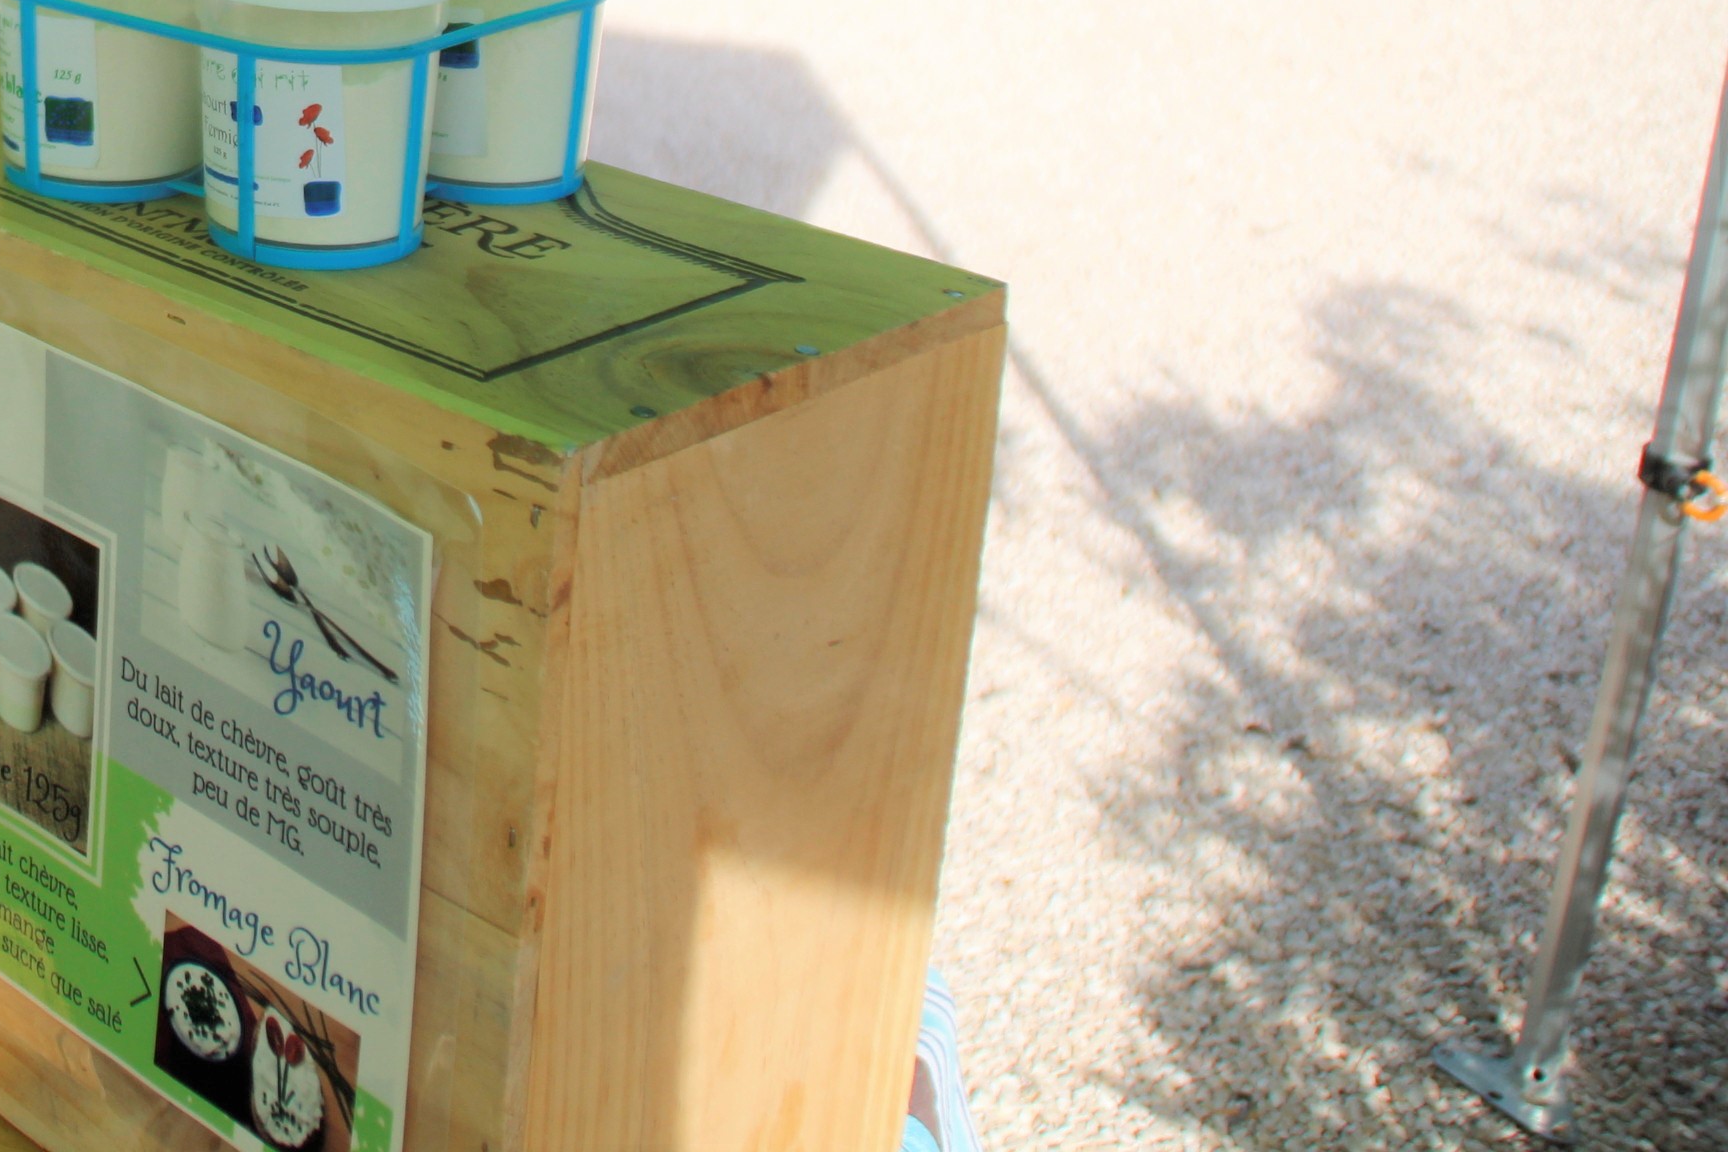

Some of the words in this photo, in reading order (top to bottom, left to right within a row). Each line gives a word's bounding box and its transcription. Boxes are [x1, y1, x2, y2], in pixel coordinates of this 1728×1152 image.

[54, 69, 72, 80] 125
[262, 620, 387, 738] Yaourt
[120, 656, 148, 692] Du
[154, 675, 185, 714] lait
[190, 700, 215, 731] de
[297, 765, 347, 811] goût
[355, 794, 393, 837] très
[187, 732, 259, 791] texture
[265, 777, 301, 818] très
[23, 766, 83, 843] 125g
[192, 771, 228, 809] peu
[235, 797, 261, 826] de
[5, 874, 66, 932] texture
[149, 836, 275, 956] Fromage
[284, 926, 381, 1016] Blanc
[1, 935, 46, 979] sucré
[50, 971, 82, 1006] que
[87, 997, 122, 1033] salé
